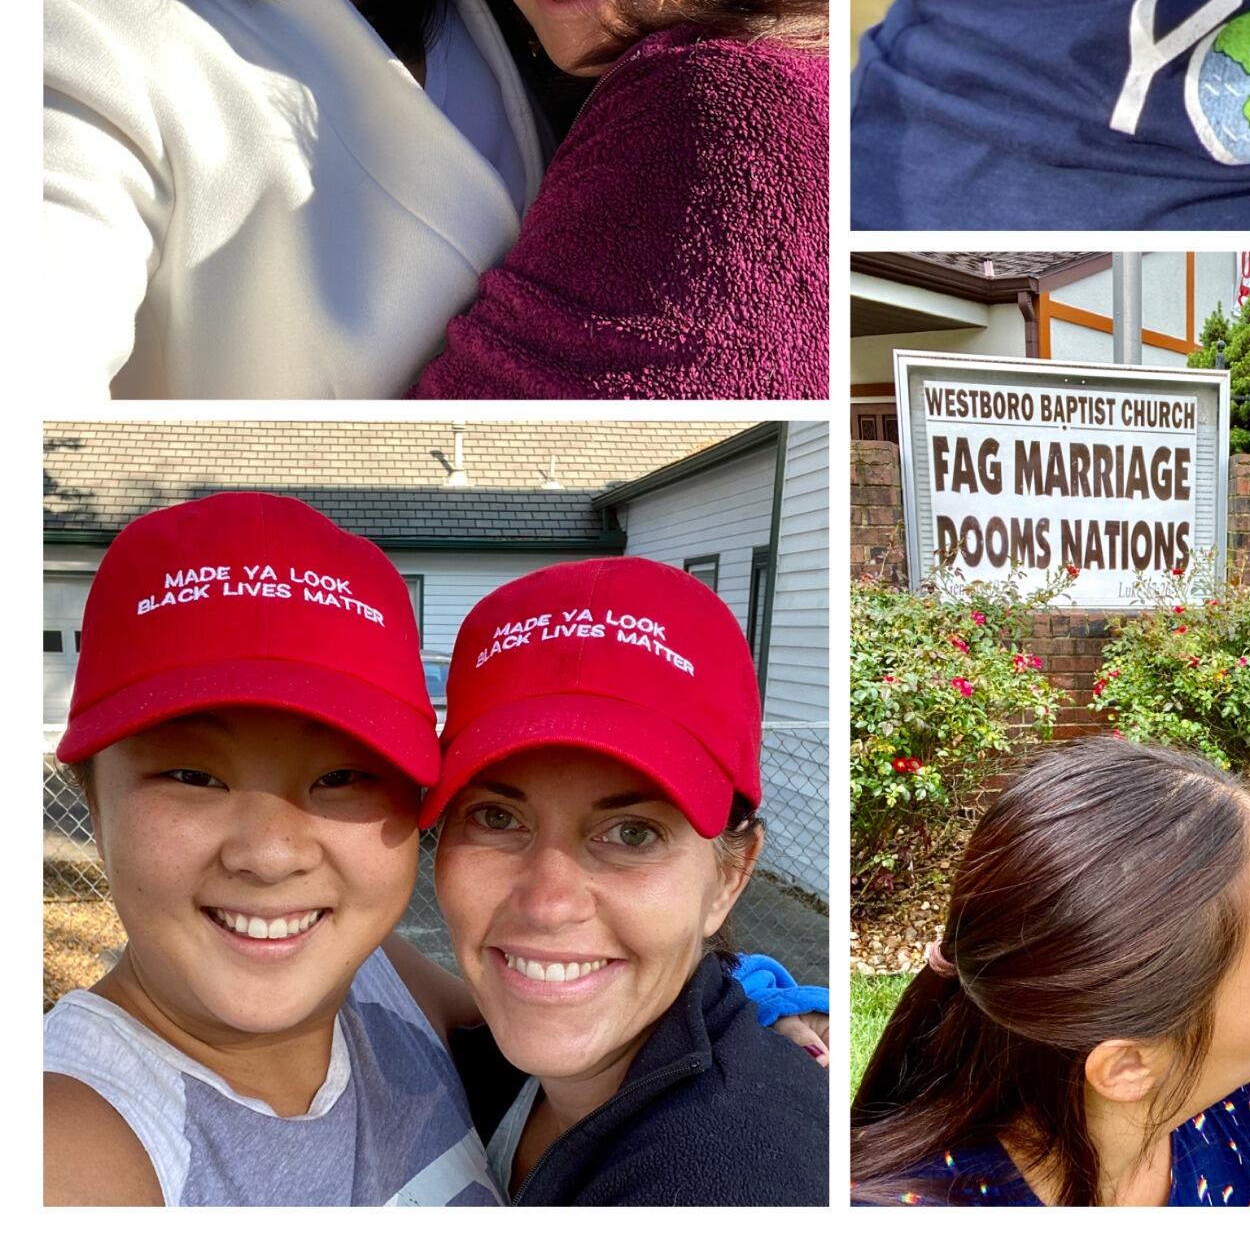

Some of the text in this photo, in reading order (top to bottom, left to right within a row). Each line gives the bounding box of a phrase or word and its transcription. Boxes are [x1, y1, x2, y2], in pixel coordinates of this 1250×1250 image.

[924, 387, 1195, 429] WESTBORO BAPTIST CHURCH
[932, 435, 1191, 501] FAG MARRIAGE
[936, 514, 1191, 574] DOOMS NATIONS
[164, 565, 353, 595] MADE YA LOOK
[137, 582, 386, 628] BLACK LIVES MATTER
[493, 608, 667, 641] MADE YA LOOK
[475, 623, 695, 677] BLACK LIVES MATTER
